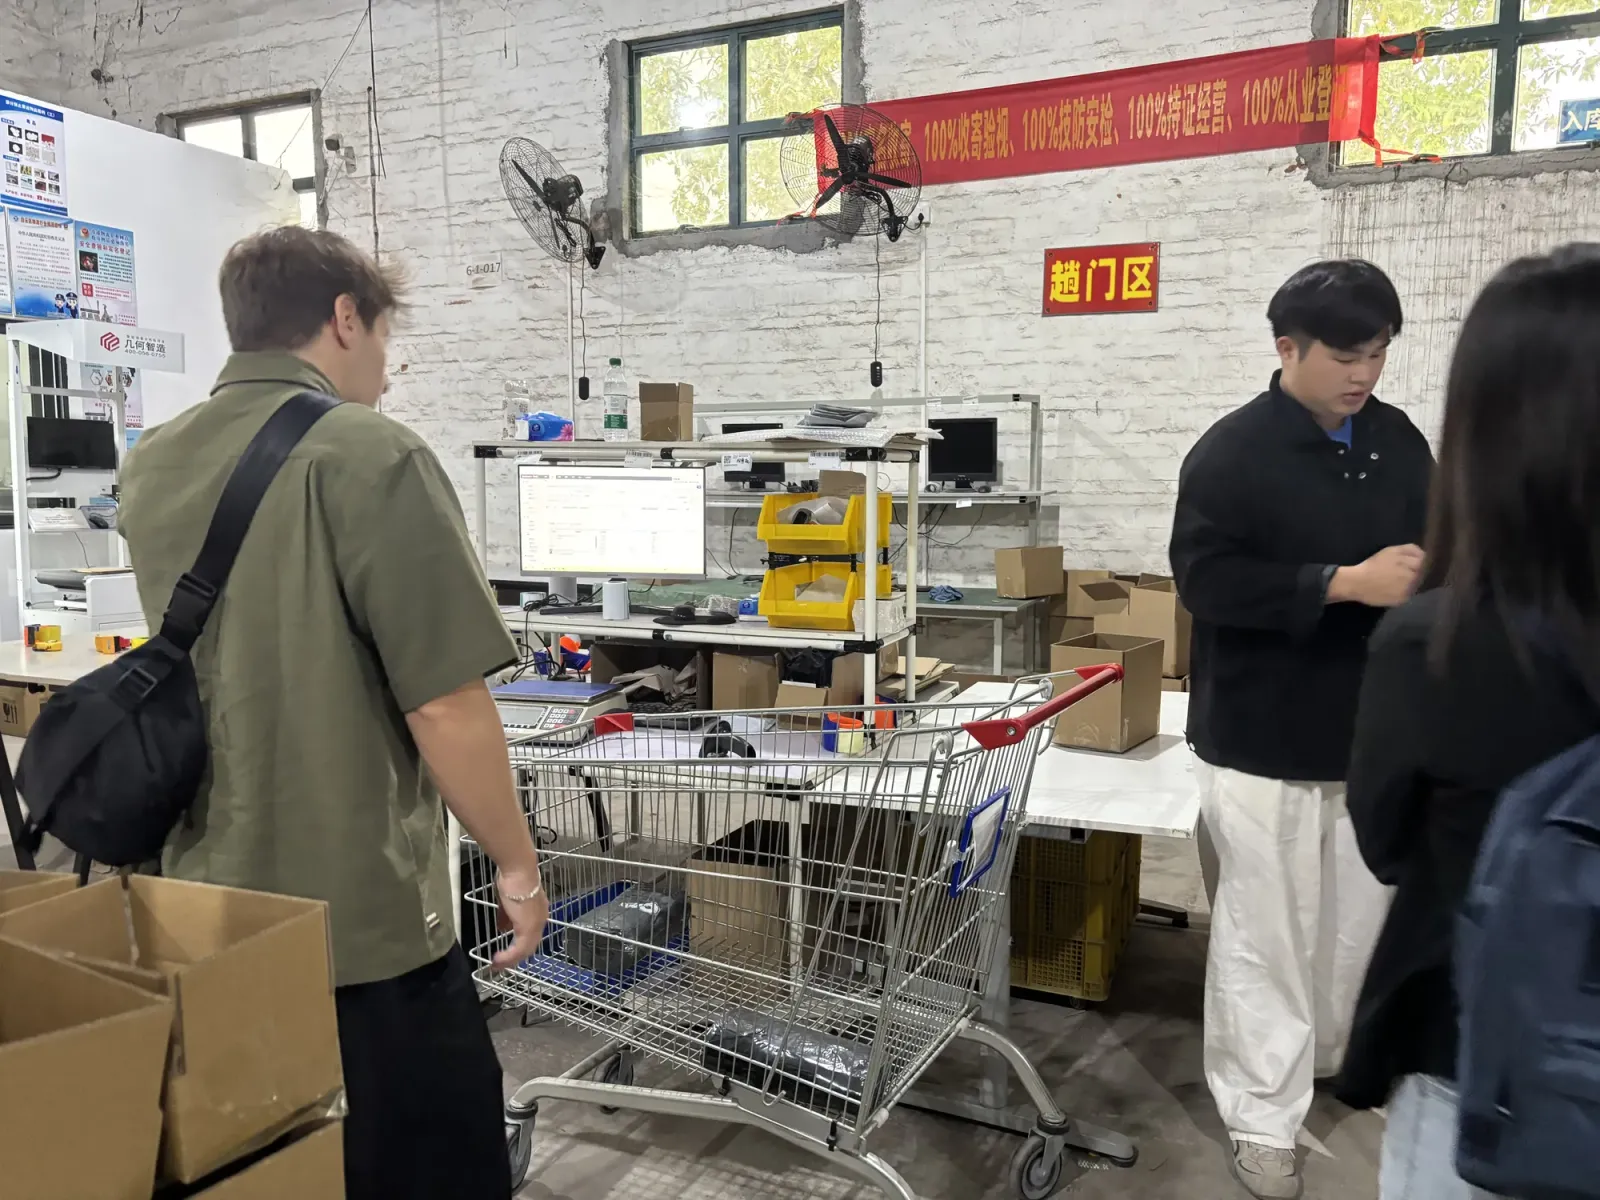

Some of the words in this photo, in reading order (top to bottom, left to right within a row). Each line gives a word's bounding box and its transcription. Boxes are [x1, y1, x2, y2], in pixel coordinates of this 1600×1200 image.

[1022, 92, 1119, 152] 100%技防安检、
[1128, 78, 1233, 141] 100%持证经营、
[466, 262, 501, 276] 6-1-017
[124, 339, 166, 353] 几何智造
